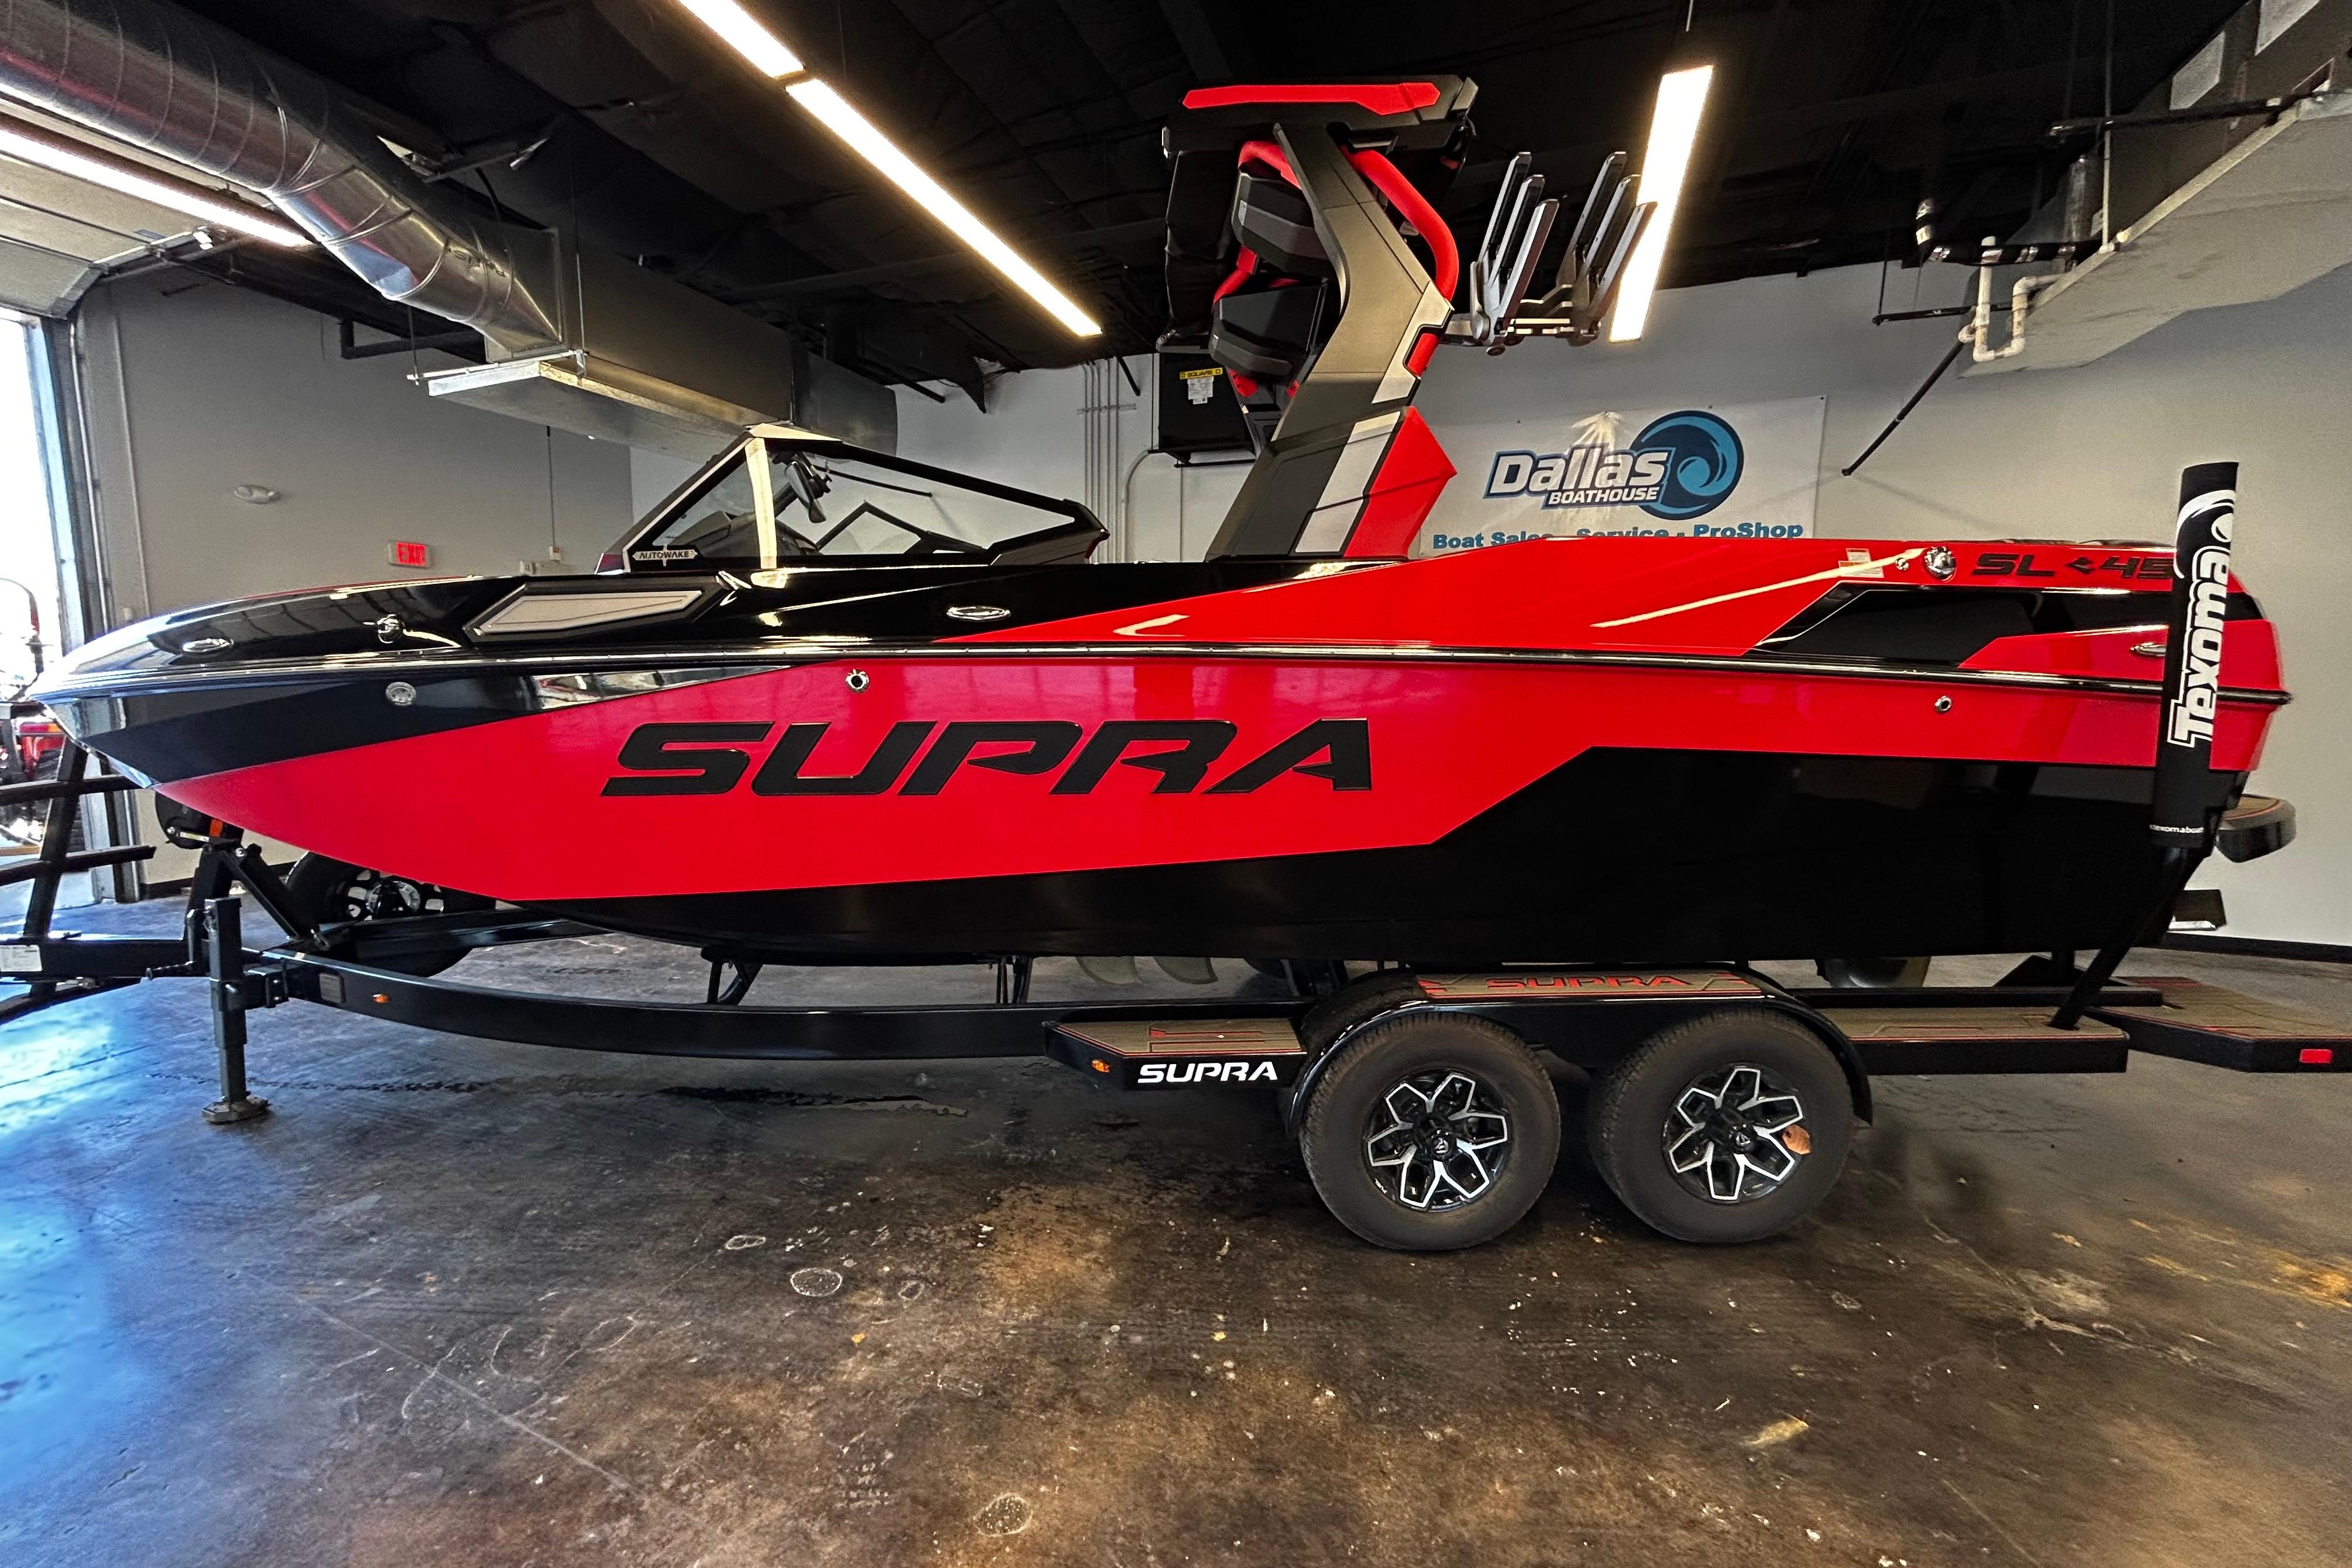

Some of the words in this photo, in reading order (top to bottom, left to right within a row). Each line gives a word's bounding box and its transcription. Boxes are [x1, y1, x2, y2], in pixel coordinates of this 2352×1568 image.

[1489, 447, 1668, 494] Dallas
[1548, 487, 1660, 505] BOATHOUSE
[1433, 533, 1484, 549] Boat
[1693, 522, 1803, 539] ProShop
[639, 551, 690, 559] AUTOWAKE
[1971, 553, 2054, 576] SL
[2169, 547, 2230, 748] Texoma
[600, 718, 1371, 797] SUPRA
[1485, 975, 1693, 990] SUPRA
[1137, 1061, 1278, 1083] SUPRA
